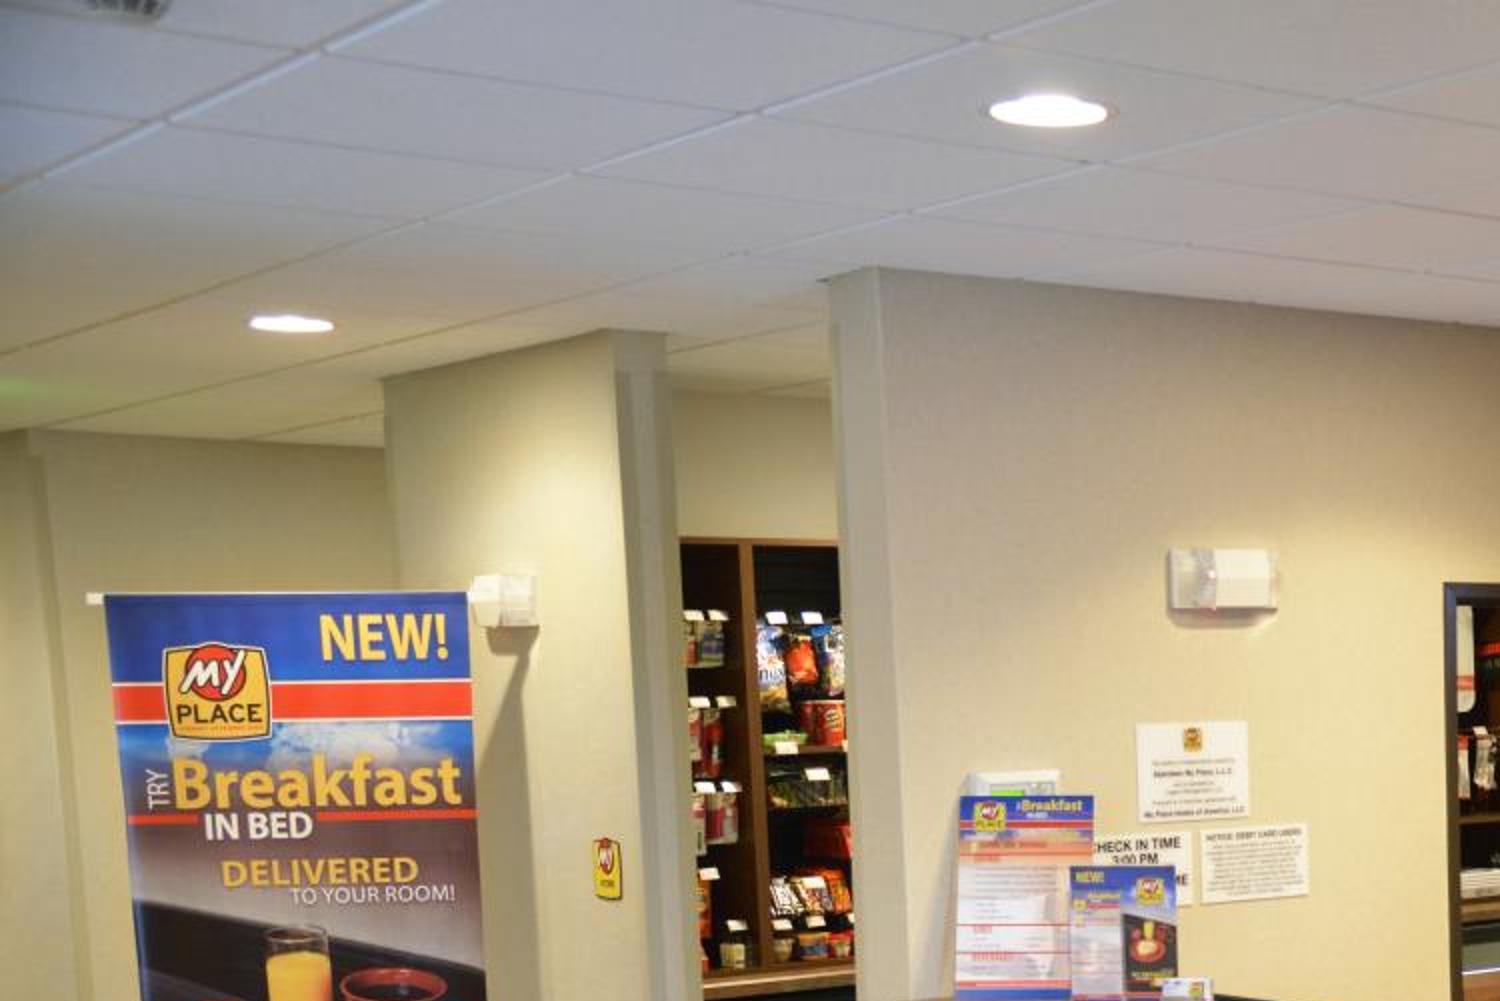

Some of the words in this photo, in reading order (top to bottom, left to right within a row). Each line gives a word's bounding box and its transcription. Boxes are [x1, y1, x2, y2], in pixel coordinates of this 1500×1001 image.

[319, 613, 449, 661] NEW!
[178, 650, 246, 695] MY
[176, 704, 262, 724] PLACE
[145, 769, 169, 810] TRY
[171, 753, 462, 810] Breakfast
[1022, 799, 1081, 812] Breakfast
[205, 812, 240, 841] IN
[248, 812, 313, 840] BED
[1094, 841, 1132, 854] HECK
[1136, 839, 1149, 851] IN
[1152, 836, 1181, 849] TIME
[1112, 854, 1137, 865] 3:00
[1140, 852, 1159, 865] PM
[221, 857, 419, 887] DELIVERED
[291, 887, 316, 905] TO
[321, 886, 380, 904] YOUR
[385, 885, 456, 902] ROOM!
